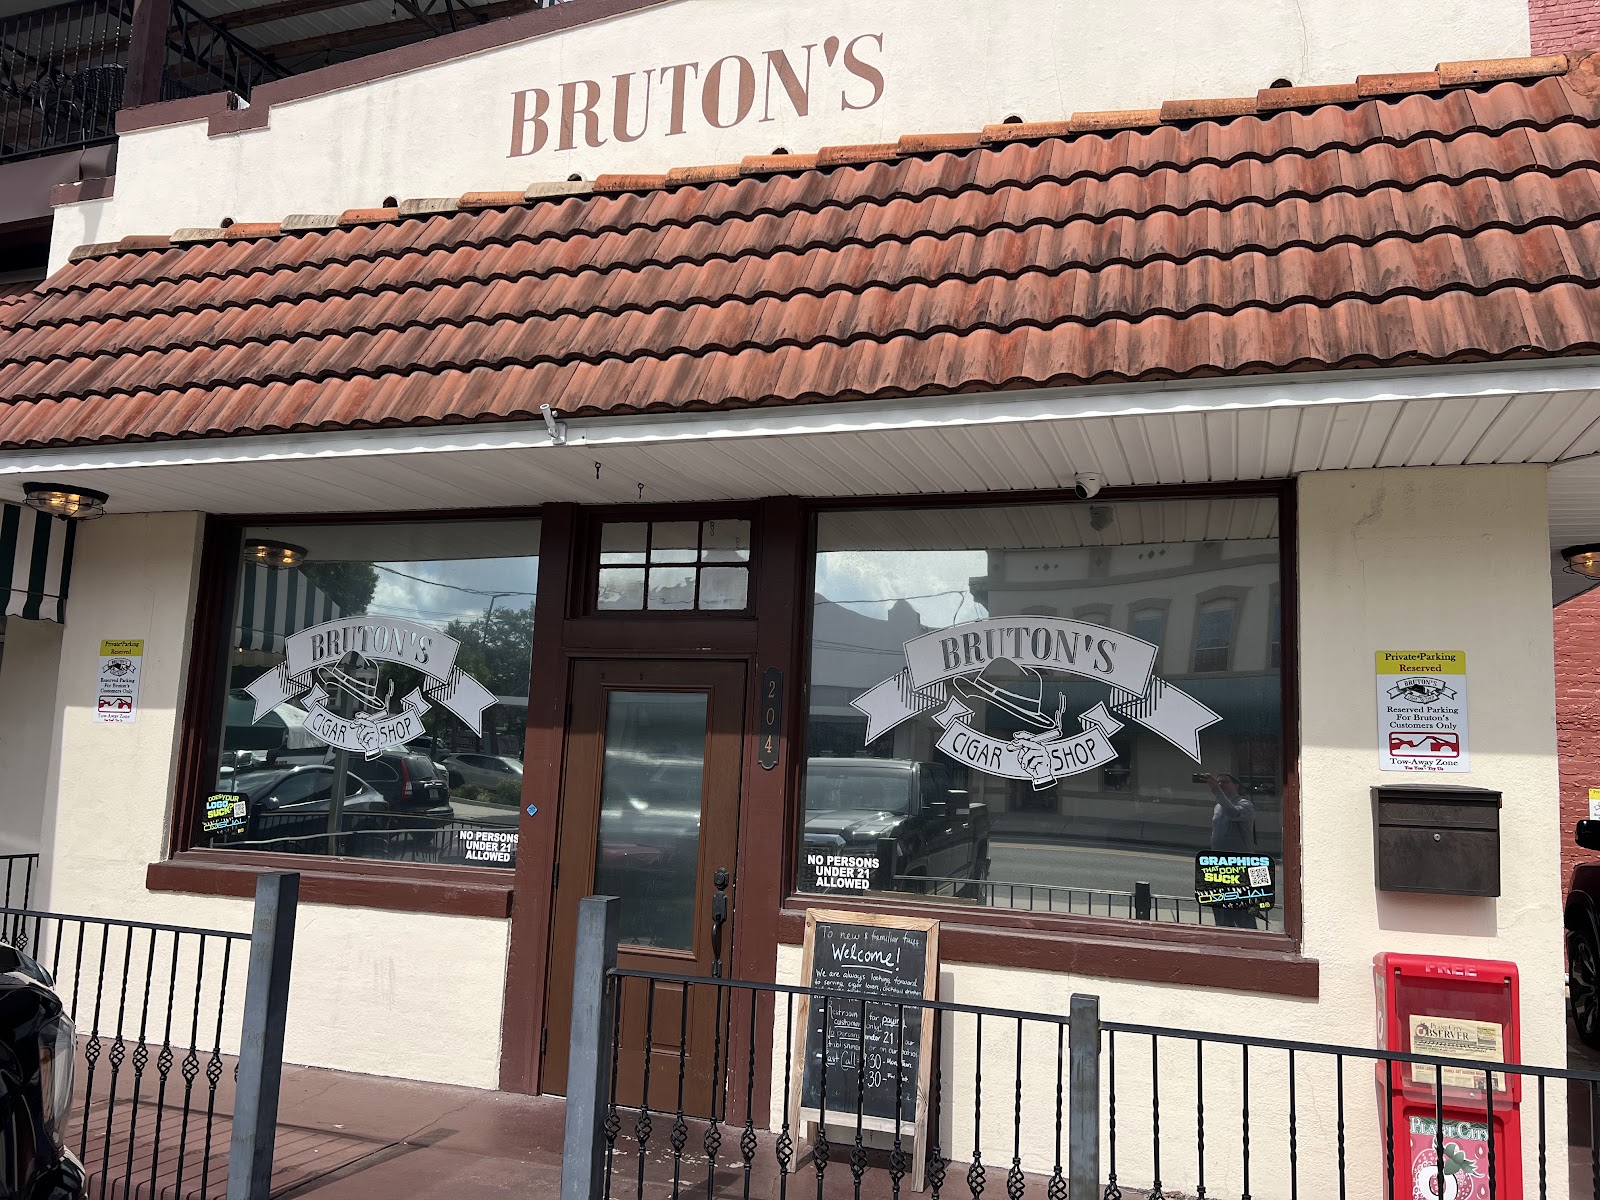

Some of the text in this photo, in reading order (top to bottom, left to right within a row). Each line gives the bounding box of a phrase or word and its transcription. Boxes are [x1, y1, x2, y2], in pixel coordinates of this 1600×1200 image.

[505, 32, 885, 159] BRUTON'S
[310, 625, 433, 665] BRUTON'S
[938, 627, 1117, 675] BRUTON'S
[1399, 664, 1442, 672] Reserved
[1404, 679, 1437, 687] BRUTON'S
[1427, 706, 1459, 715] Parking
[1413, 714, 1450, 722] Bruton's
[312, 713, 412, 745] CIGAR SHOP
[1436, 722, 1457, 731] Only
[952, 732, 1096, 771] CIGAR SHOP
[1390, 757, 1459, 766] Tow-Away Zone
[206, 800, 228, 810] LOGO
[459, 830, 519, 844] NO PERSONS
[466, 840, 512, 853] UNDER 21
[465, 850, 511, 863] ALLOWED
[807, 854, 880, 869] NO PERSONS
[1199, 856, 1270, 866] GRAPHICS
[815, 865, 870, 879] UNDER 21
[1219, 866, 1247, 875] DON'T
[815, 876, 870, 890] ALLOWED
[1204, 873, 1241, 884] SUCK
[819, 925, 834, 939] To
[840, 932, 860, 940] new
[871, 929, 899, 943] familiar
[831, 943, 901, 972] Welcome!
[1425, 963, 1477, 977] FREE
[815, 968, 827, 978] We
[843, 970, 866, 984] always
[894, 976, 918, 987] forward
[824, 979, 844, 988] serving
[868, 1011, 880, 1021] for
[883, 1031, 893, 1045] 21
